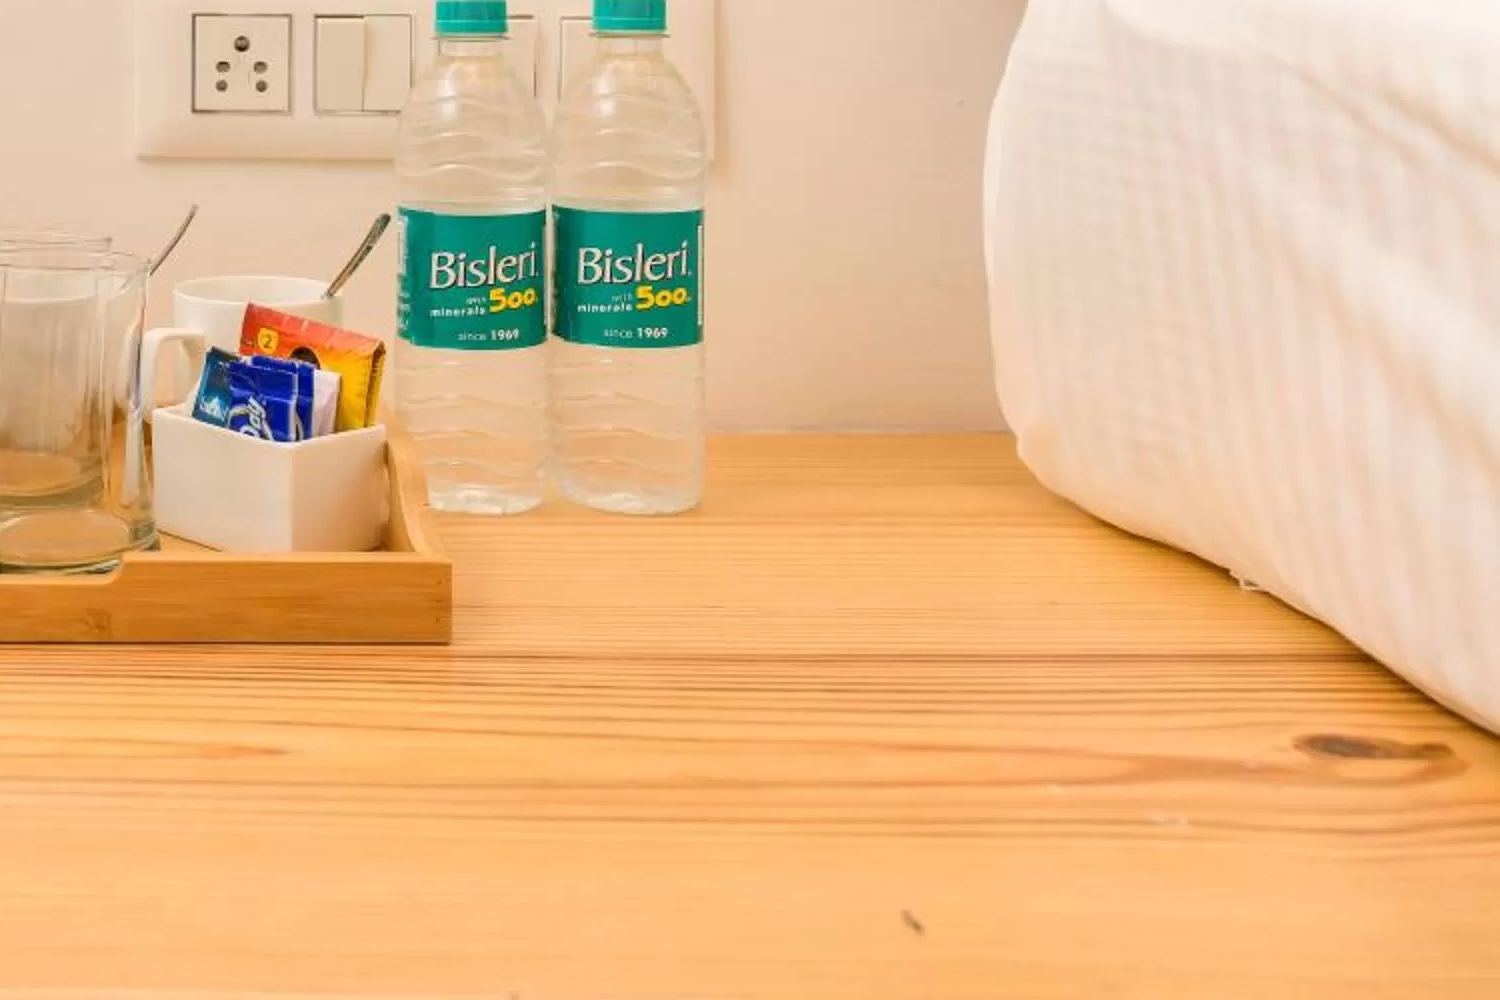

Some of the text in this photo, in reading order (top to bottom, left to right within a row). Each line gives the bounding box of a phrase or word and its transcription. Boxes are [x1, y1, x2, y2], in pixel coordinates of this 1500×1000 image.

[428, 240, 537, 289] Bisleri
[577, 239, 689, 284] Bisleri
[488, 286, 537, 313] 500
[635, 285, 688, 310] 500
[457, 327, 520, 341] since 1969
[636, 327, 669, 339] 1969
